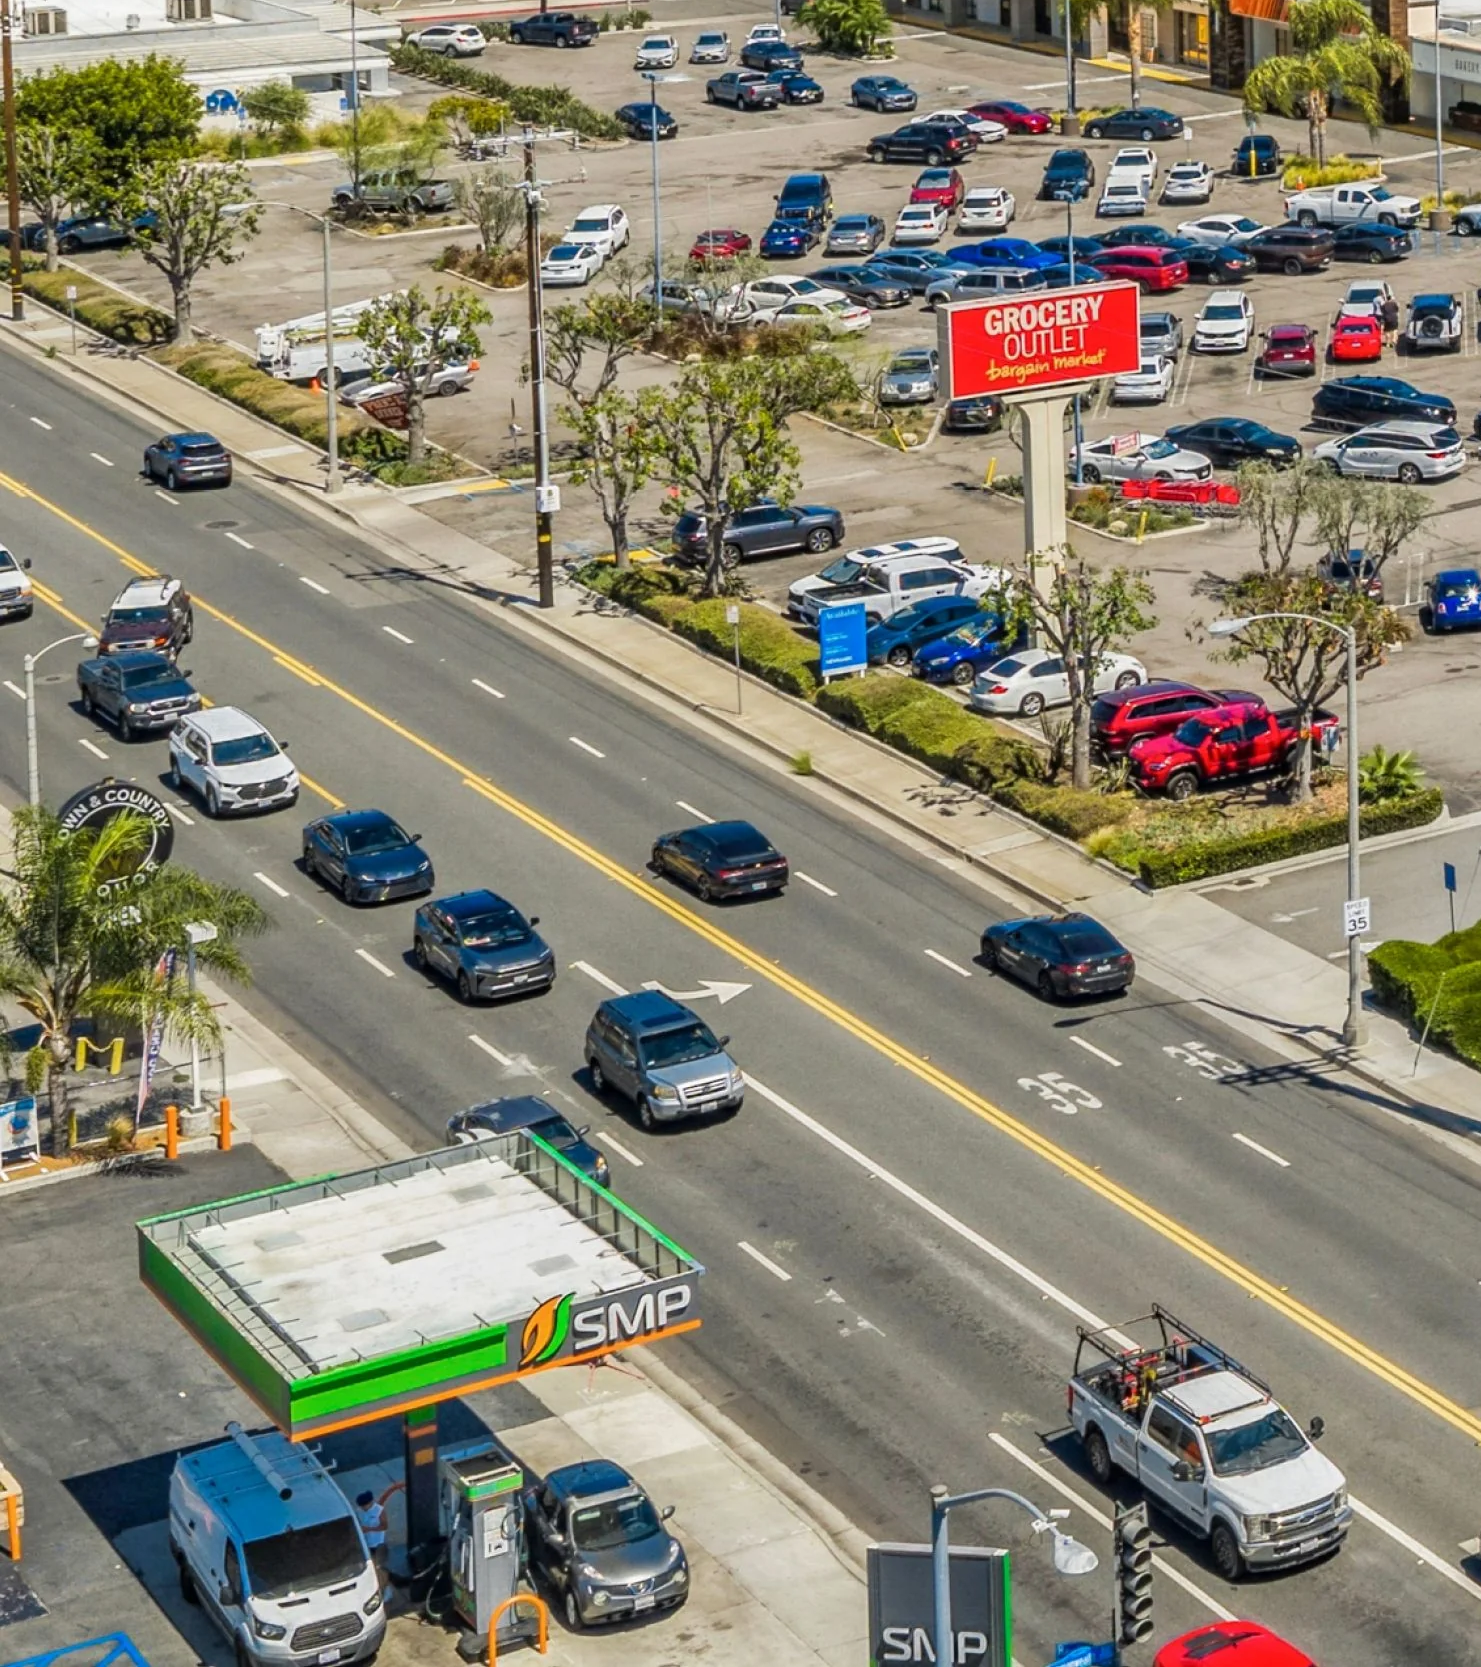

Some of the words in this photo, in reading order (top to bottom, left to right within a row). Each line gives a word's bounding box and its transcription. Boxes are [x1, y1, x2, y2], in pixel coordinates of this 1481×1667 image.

[984, 294, 1105, 337] GROCERY
[1003, 323, 1089, 362] OUTLET
[985, 359, 1052, 384] bargain
[1053, 349, 1105, 368] market
[57, 803, 89, 841] OWN
[89, 795, 102, 808] &
[104, 789, 171, 828] COUNTRY
[1347, 916, 1368, 932] 35
[1162, 1040, 1248, 1080] 35
[1017, 1072, 1103, 1115] 35
[573, 1283, 692, 1353] SMP
[882, 1627, 988, 1665] SMP
